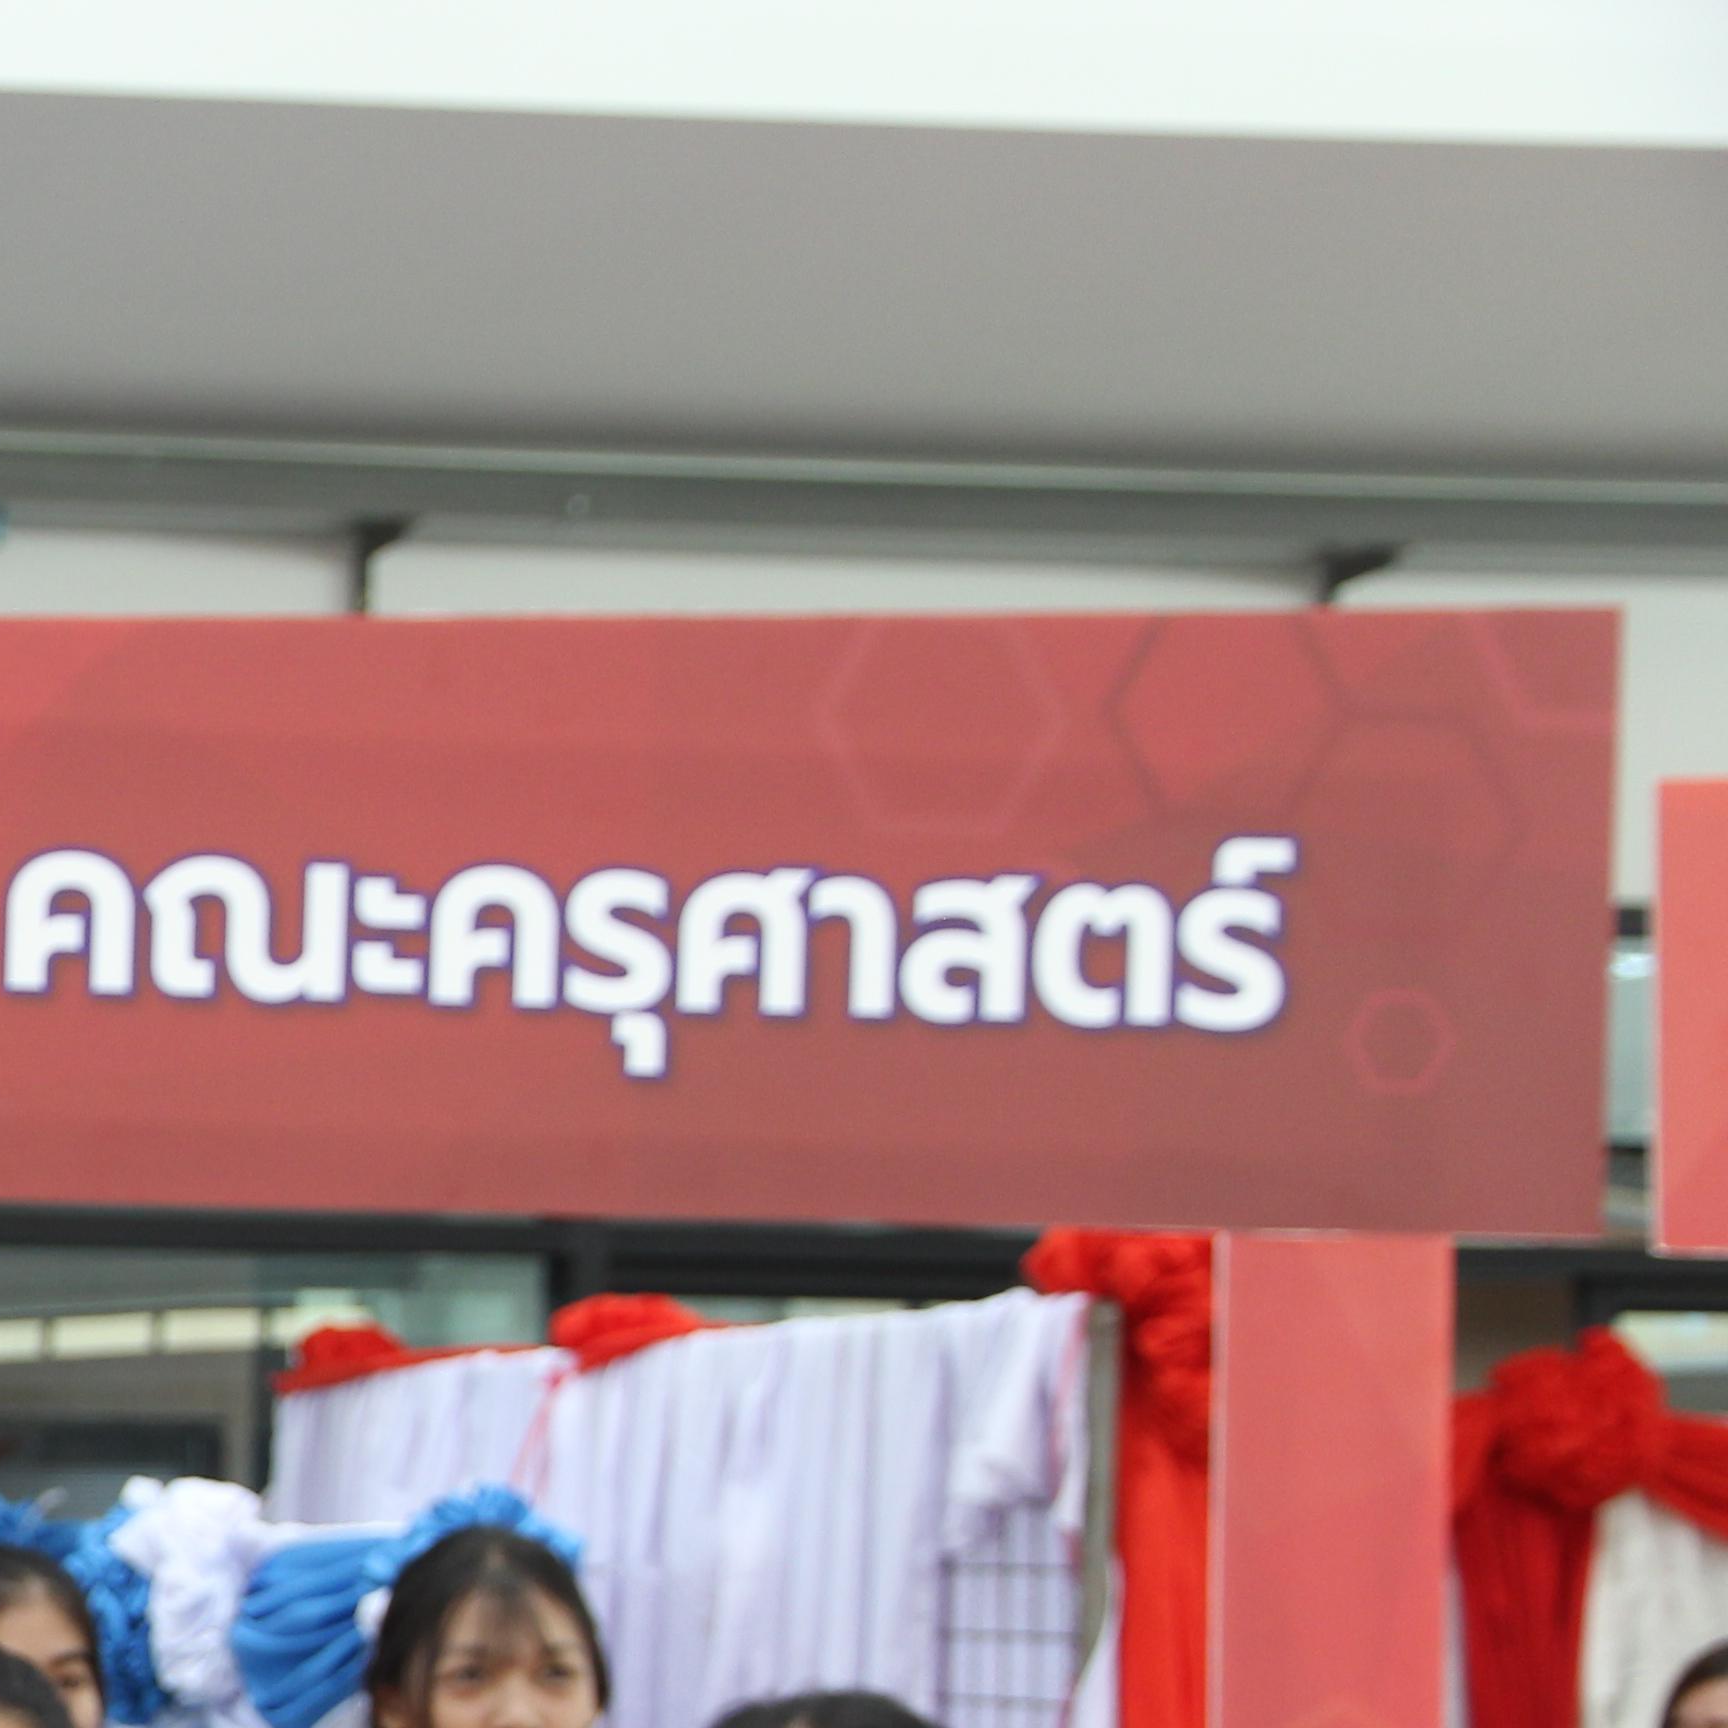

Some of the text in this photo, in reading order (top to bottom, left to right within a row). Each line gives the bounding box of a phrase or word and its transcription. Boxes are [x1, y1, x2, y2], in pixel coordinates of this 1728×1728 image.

[2, 834, 1300, 1079] คณะครุศาสตร์
